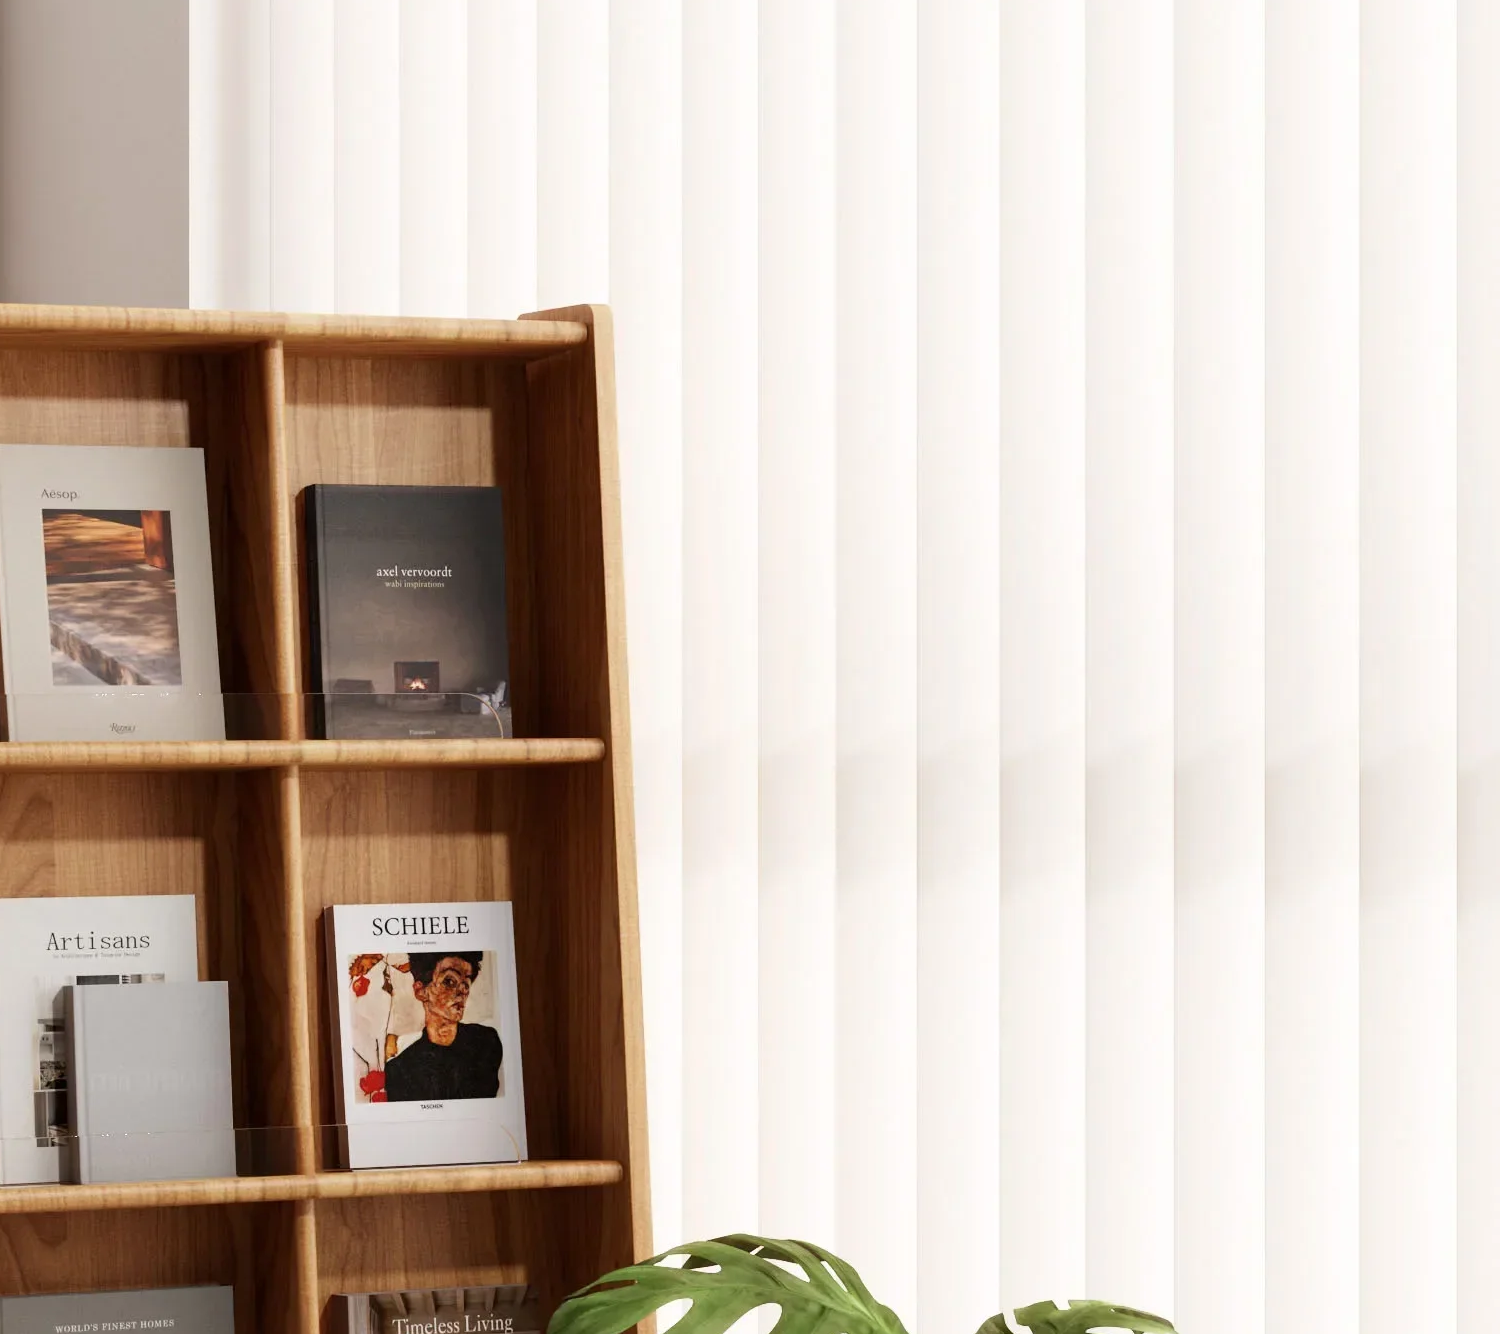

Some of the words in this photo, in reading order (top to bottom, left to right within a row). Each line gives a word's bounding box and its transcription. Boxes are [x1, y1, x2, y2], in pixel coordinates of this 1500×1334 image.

[376, 564, 398, 577] axel
[401, 565, 453, 577] vervoordt
[404, 579, 445, 589] inspirations
[372, 915, 470, 936] SCHIELE
[46, 931, 150, 951] Artisans
[55, 1323, 99, 1334] WORLD'S
[101, 1321, 137, 1331] FINEST
[140, 1319, 175, 1329] HOMES
[464, 1313, 514, 1334] Living
